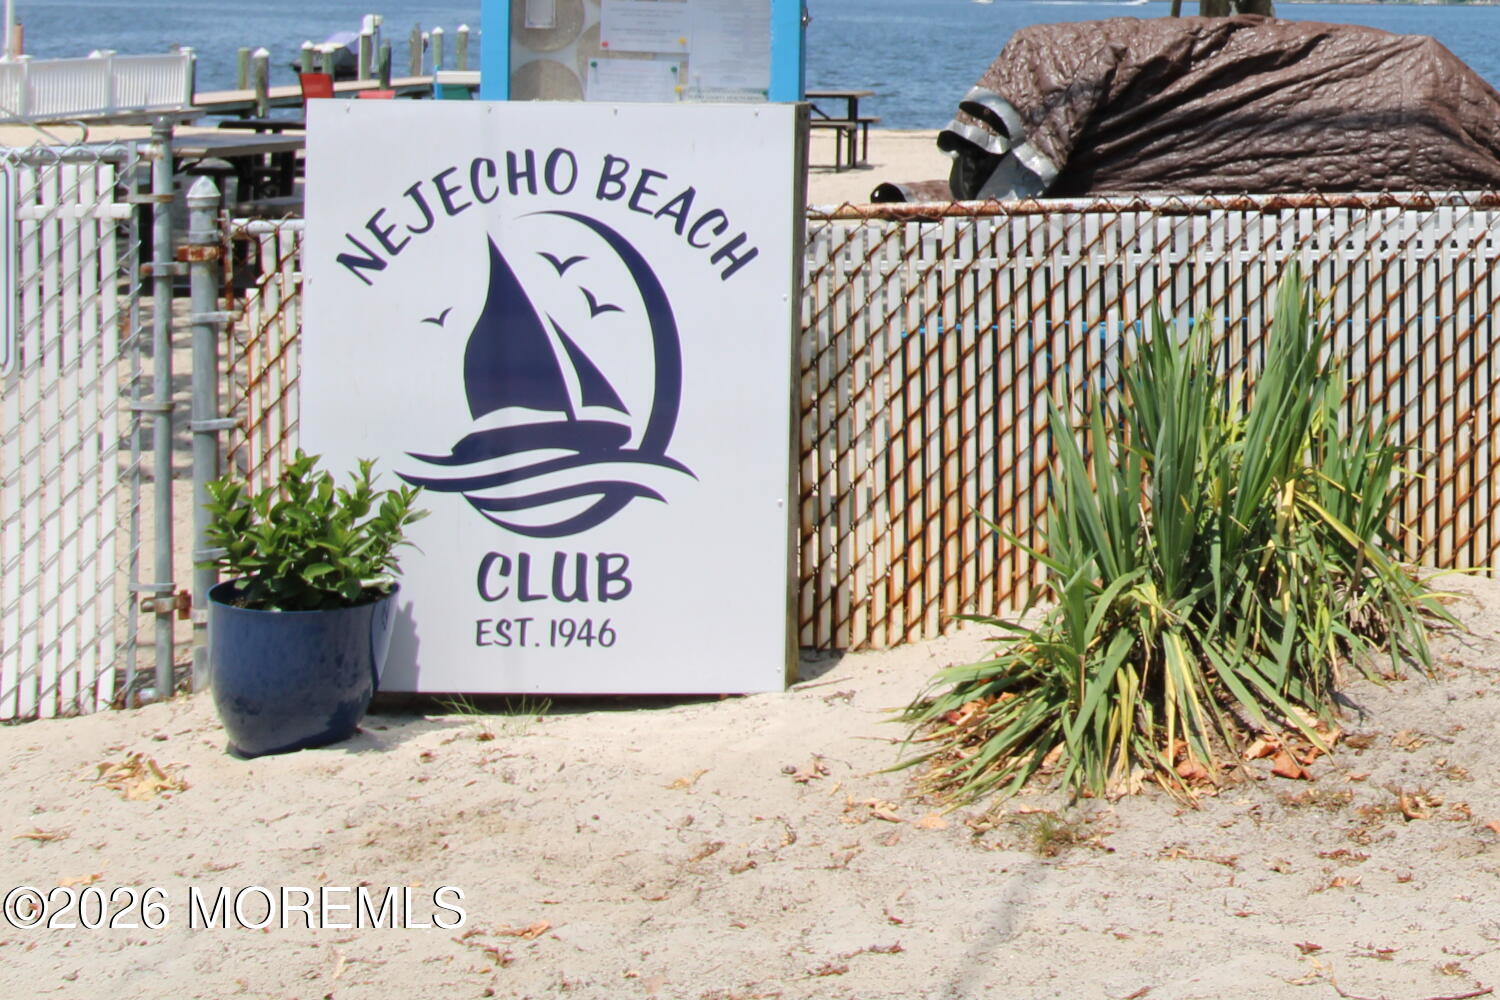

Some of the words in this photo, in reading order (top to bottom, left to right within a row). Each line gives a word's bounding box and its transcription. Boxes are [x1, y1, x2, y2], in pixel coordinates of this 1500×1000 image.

[335, 147, 578, 286] NEJECHO
[595, 153, 759, 281] BEACH
[476, 551, 632, 603] CLUB
[475, 617, 540, 648] EST.
[550, 617, 616, 648] 1946
